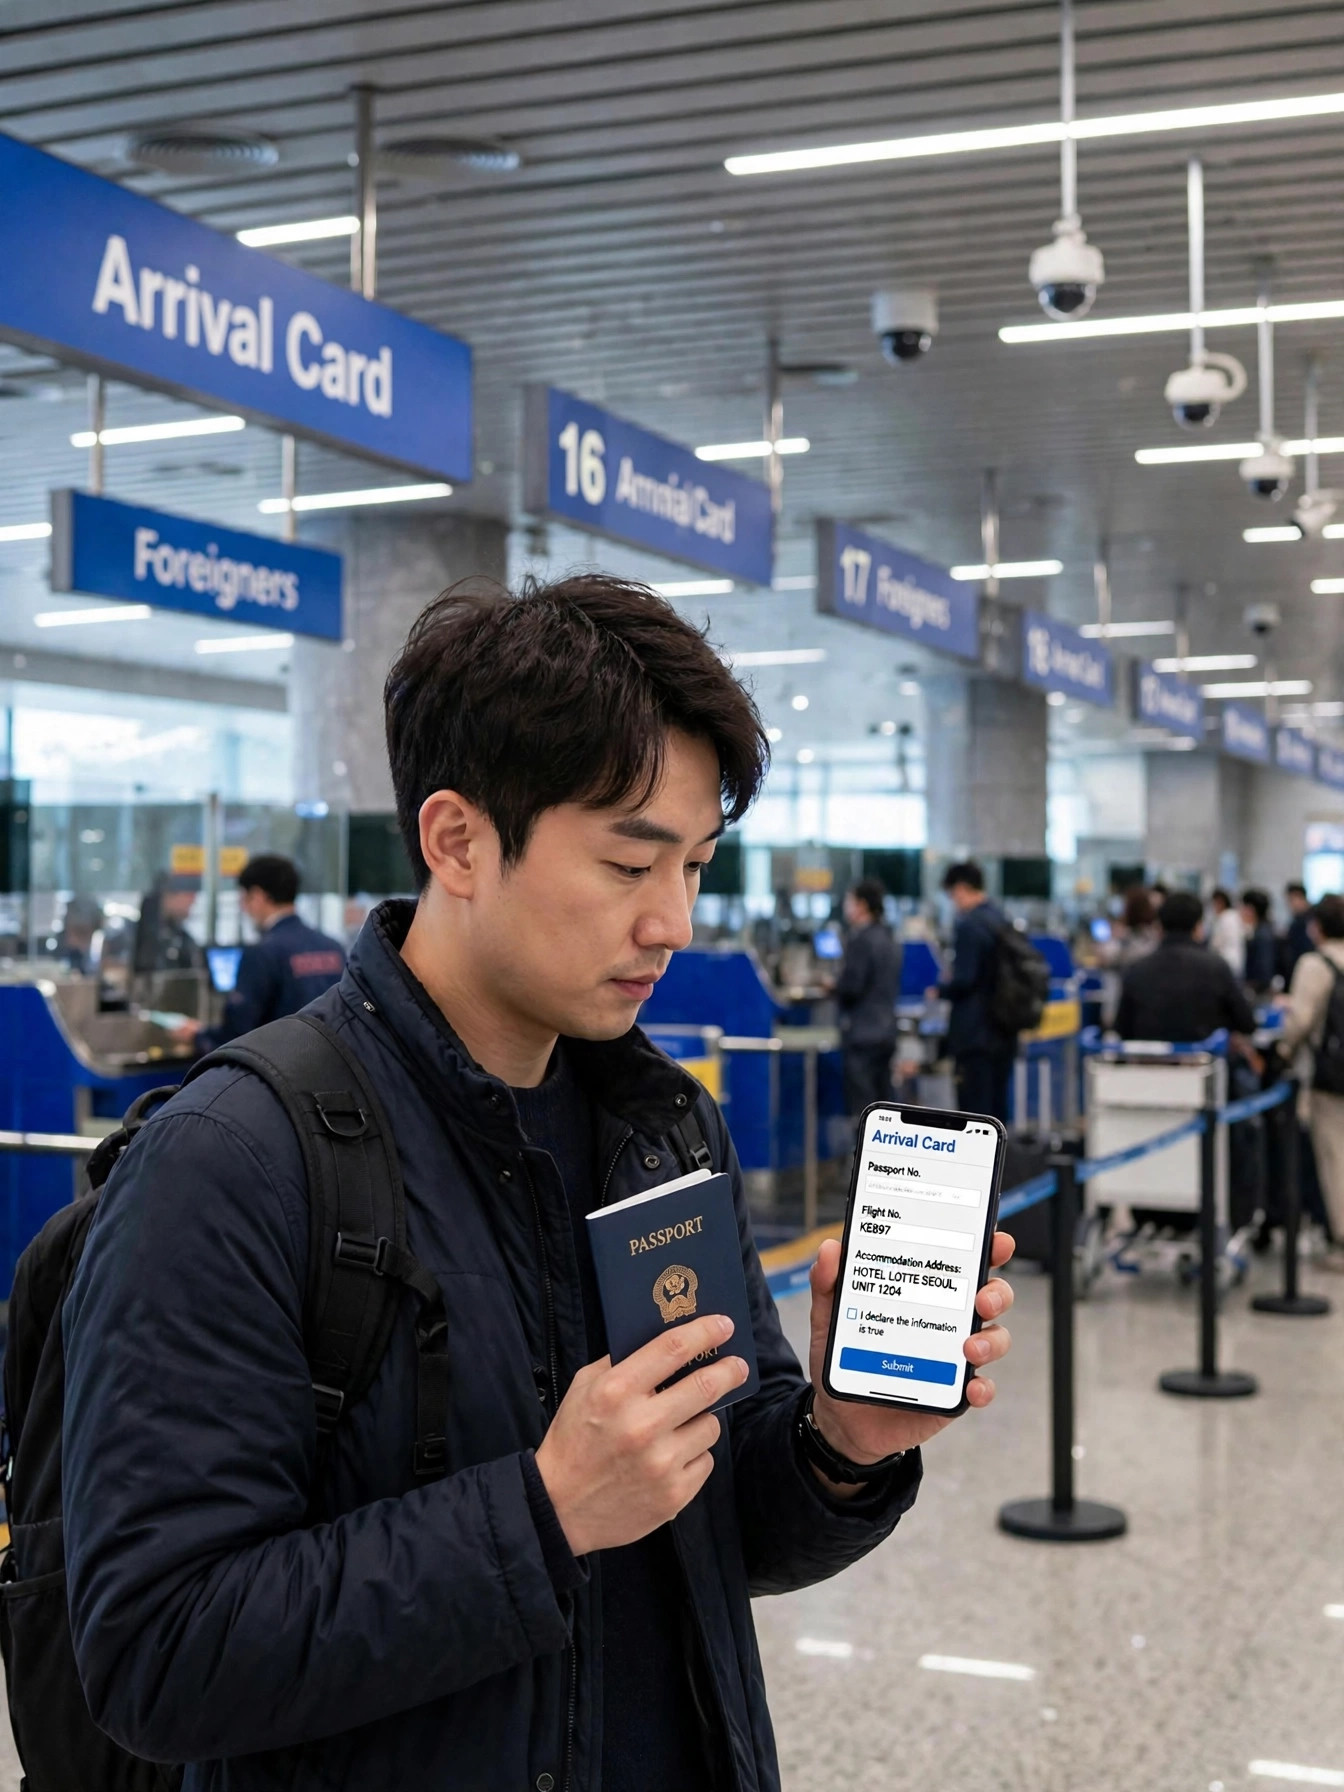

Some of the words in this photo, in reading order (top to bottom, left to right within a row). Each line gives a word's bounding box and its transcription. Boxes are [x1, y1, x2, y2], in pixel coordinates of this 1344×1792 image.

[92, 234, 273, 374] Arrival
[285, 311, 392, 418] Card
[558, 421, 606, 506] 16
[134, 526, 299, 612] Foreigners
[840, 544, 872, 608] 17
[872, 1129, 918, 1148] Arrival
[922, 1136, 956, 1153] Card
[867, 1161, 905, 1176] Passport
[906, 1167, 921, 1178] No.
[861, 1205, 886, 1219] Flight
[887, 1209, 902, 1219] No.
[628, 1215, 704, 1257] PASSPORT
[860, 1222, 891, 1235] KE897
[855, 1249, 923, 1269] Accommodation
[924, 1259, 962, 1274] Address:
[851, 1280, 876, 1293] UNIT
[878, 1284, 902, 1297] 1204
[853, 1266, 886, 1281] HOTEL
[888, 1271, 920, 1285] LOTTE
[921, 1275, 958, 1292] SEOUL,
[858, 1323, 866, 1334] is
[867, 1325, 885, 1337] true
[860, 1310, 864, 1320] I
[864, 1310, 895, 1325] declare
[896, 1315, 910, 1327] the
[910, 1317, 957, 1333] information
[881, 1359, 914, 1374] Submit
